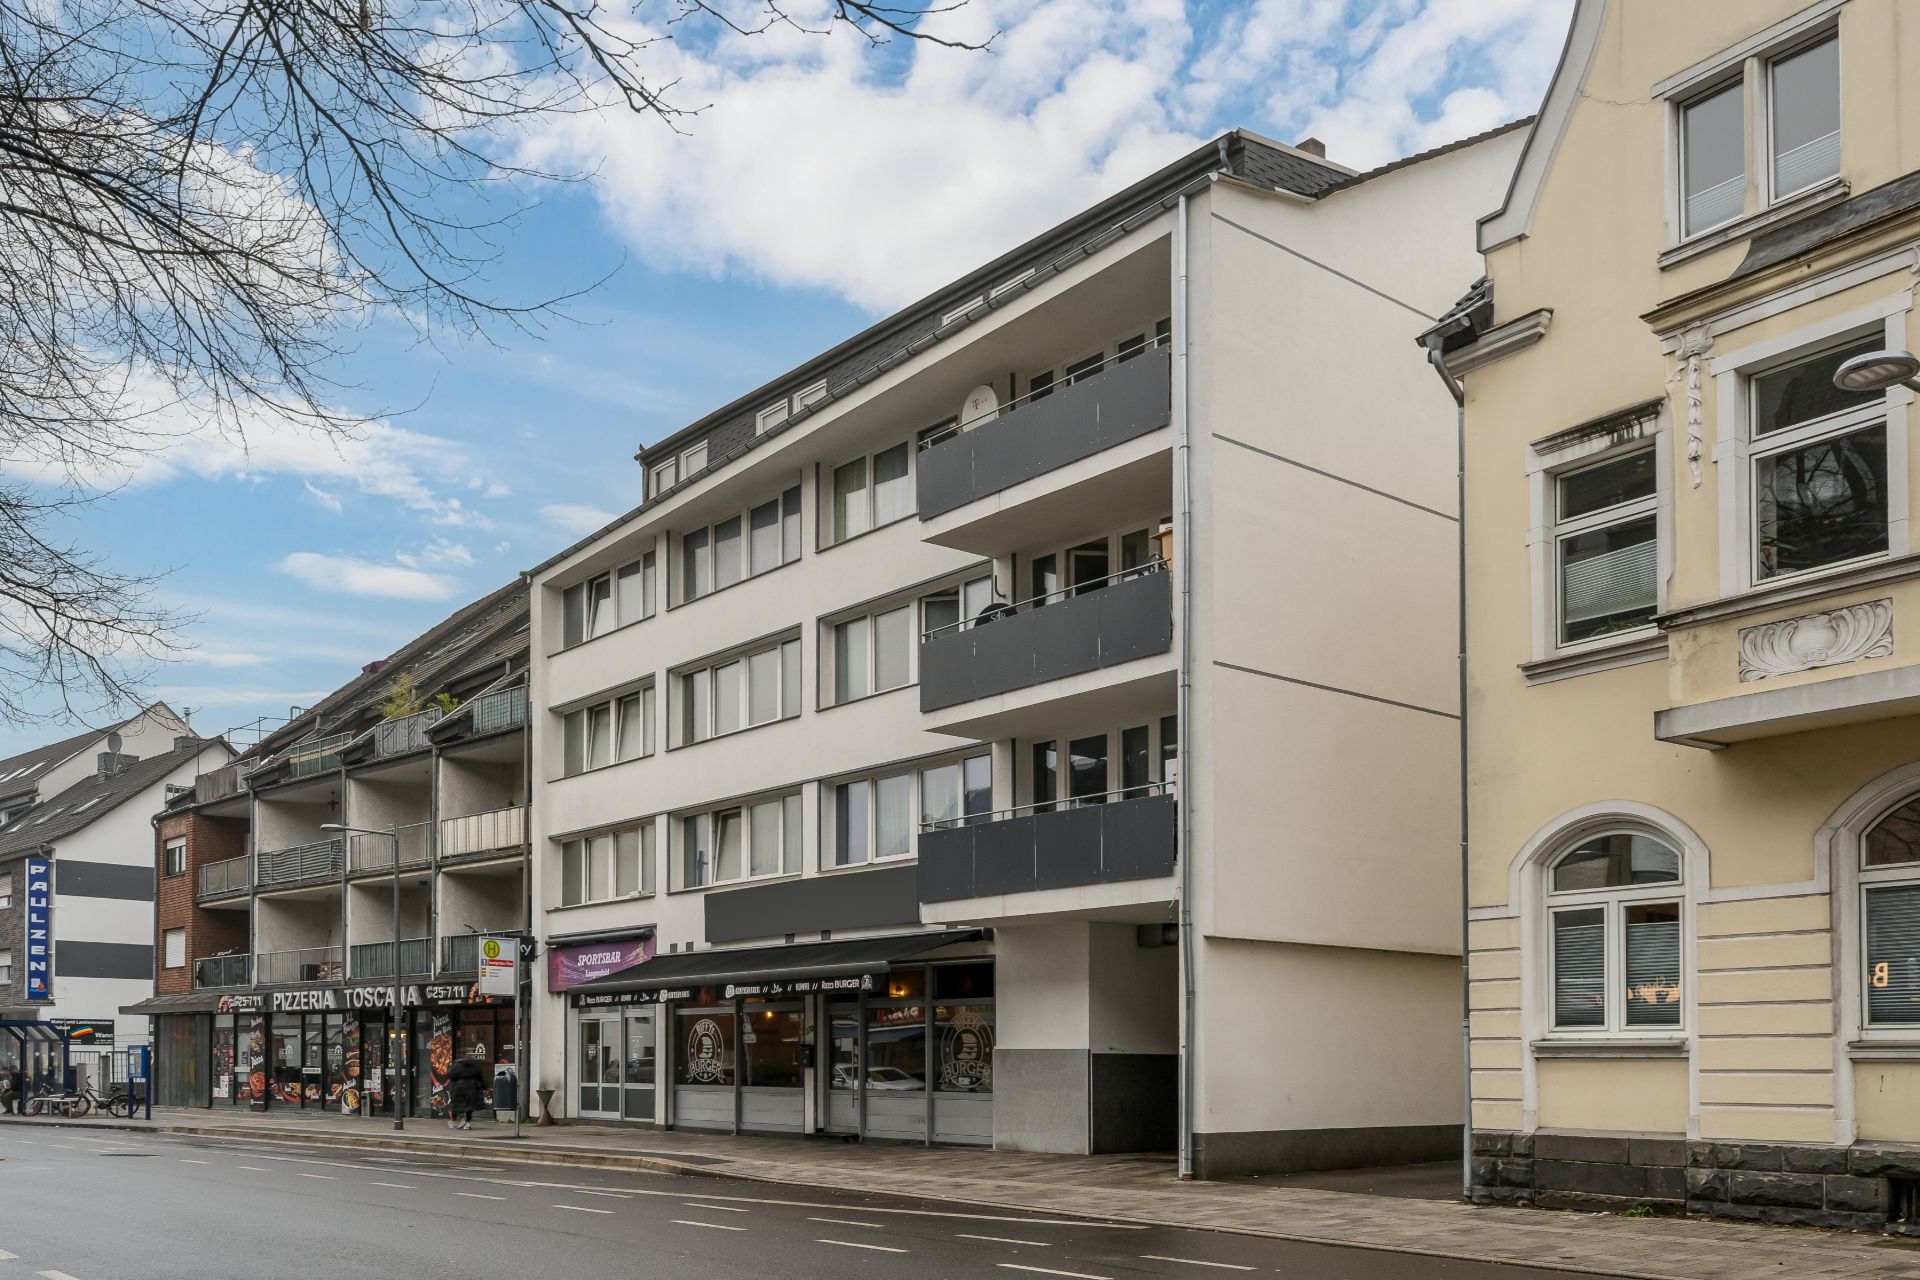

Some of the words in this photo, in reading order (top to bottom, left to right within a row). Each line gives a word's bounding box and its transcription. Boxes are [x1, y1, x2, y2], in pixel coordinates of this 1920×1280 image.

[30, 865, 48, 972] PAULZEN
[577, 951, 621, 967] SPORTSBAR
[834, 979, 860, 989] BURGER
[273, 990, 336, 1011] PIZZERIA
[690, 1060, 722, 1074] BURGER
[944, 1061, 991, 1079] BURGER
